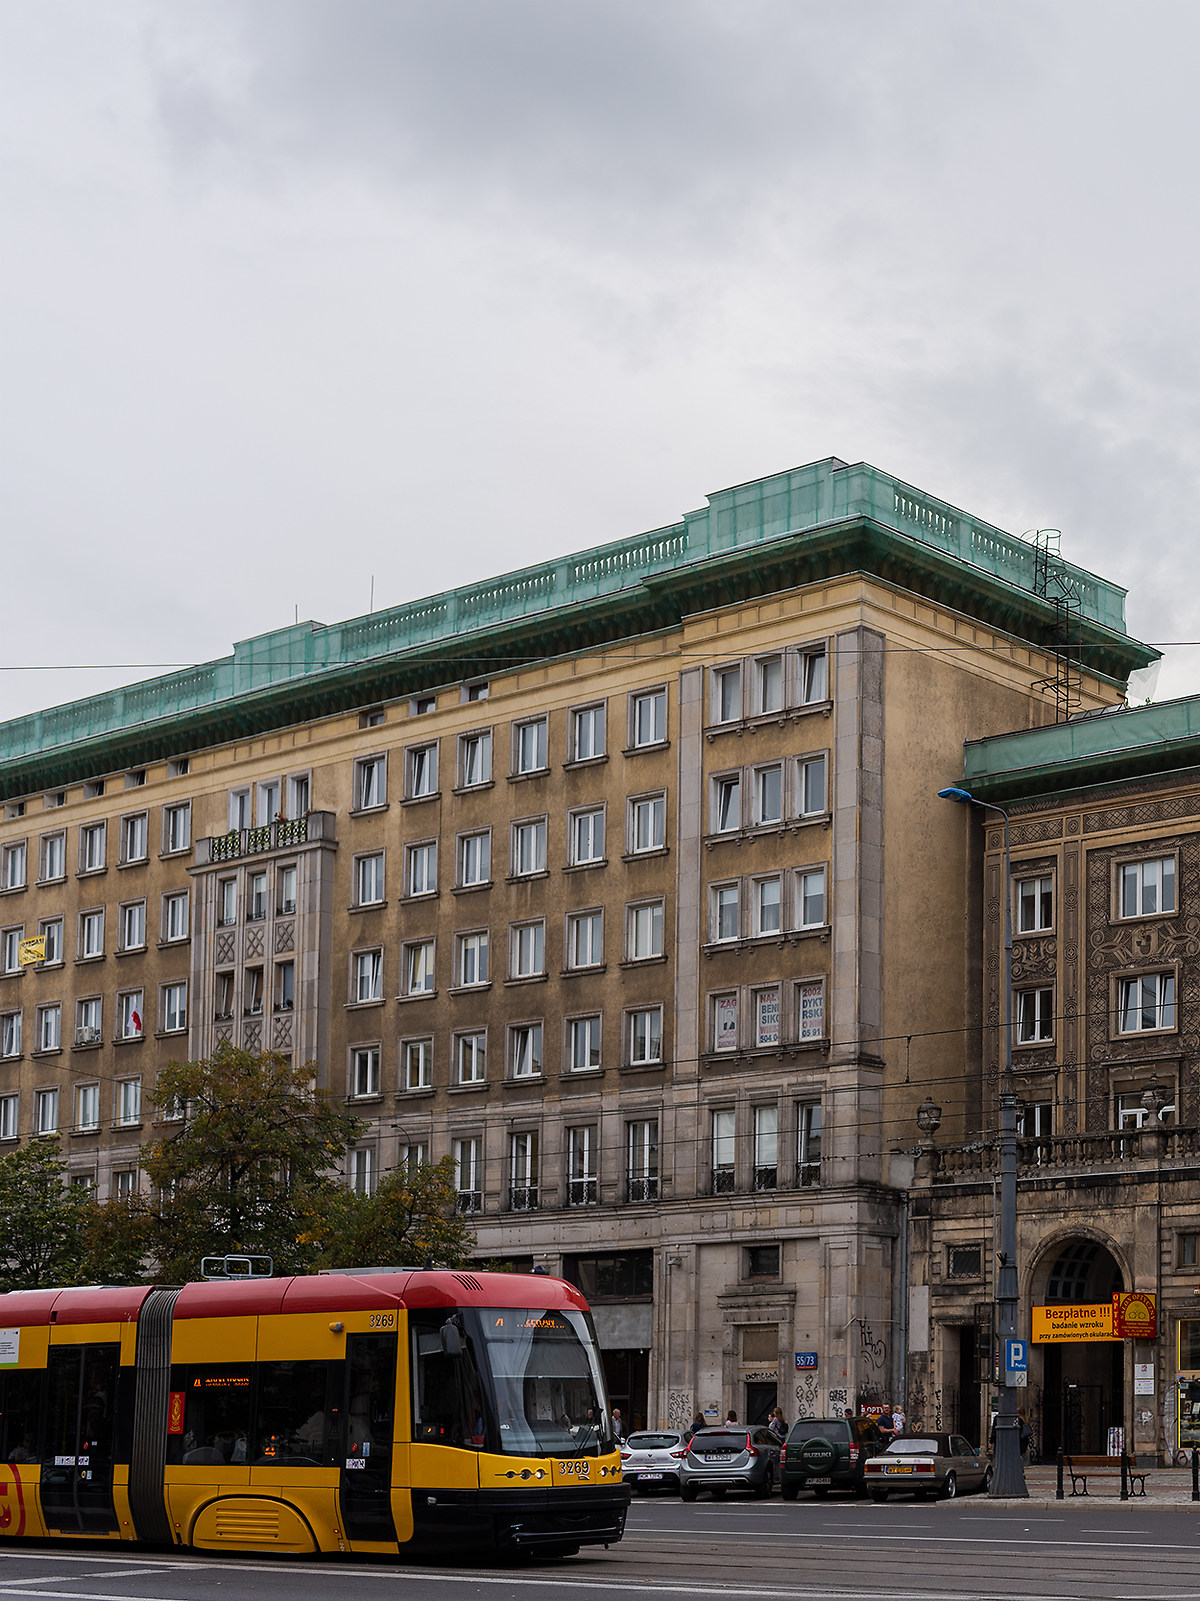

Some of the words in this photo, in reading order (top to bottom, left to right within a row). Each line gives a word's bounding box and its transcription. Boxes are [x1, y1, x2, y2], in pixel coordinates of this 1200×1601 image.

[803, 987, 821, 997] 2002
[802, 997, 822, 1008] DYKT
[762, 1004, 779, 1013] BEN
[1045, 1308, 1097, 1321] Bezpłatne
[369, 1314, 394, 1328] 3269
[1051, 1322, 1078, 1330] badanie
[1079, 1321, 1104, 1329] wzroku
[1011, 1343, 1023, 1367] P
[797, 1356, 815, 1365] 55/73
[866, 1406, 884, 1414] OPTY
[559, 1461, 590, 1475] 3269
